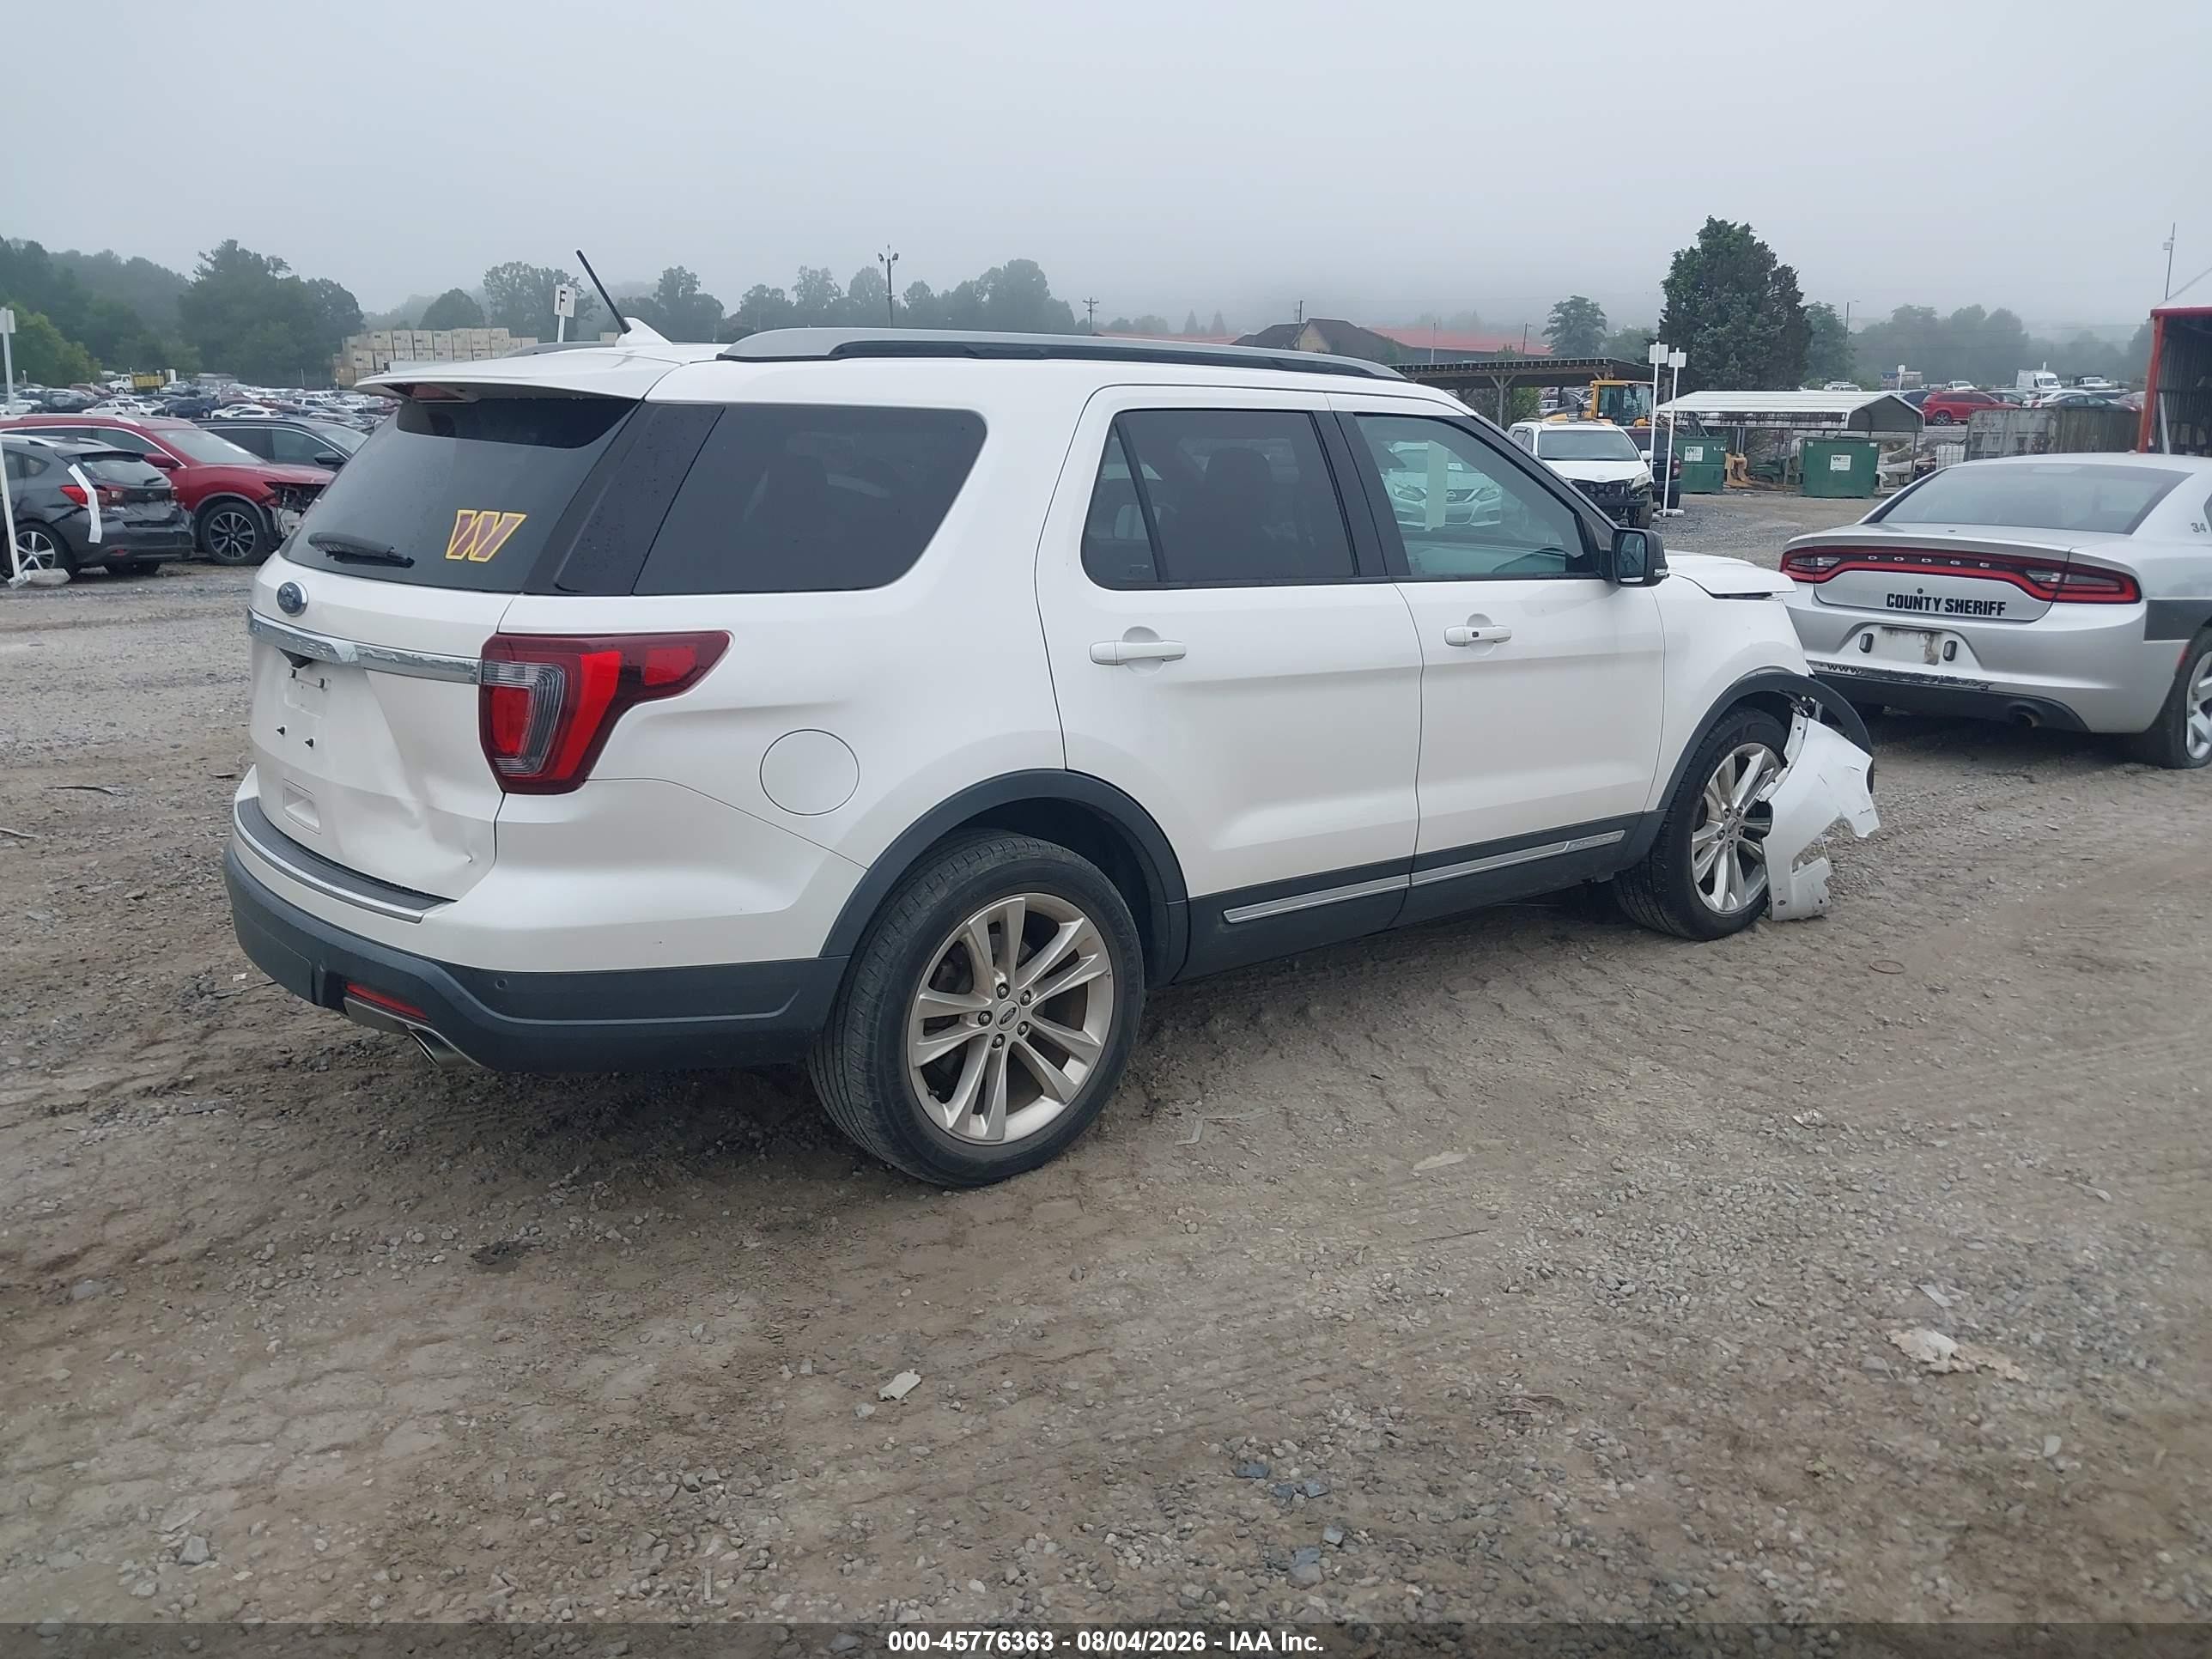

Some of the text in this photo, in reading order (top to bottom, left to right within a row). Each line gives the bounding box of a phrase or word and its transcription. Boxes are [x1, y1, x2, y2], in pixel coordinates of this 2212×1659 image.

[558, 289, 567, 311] F
[446, 509, 527, 562] W
[1868, 555, 1990, 568] DODGE
[1886, 592, 2007, 616] COUNTY SHERIFF
